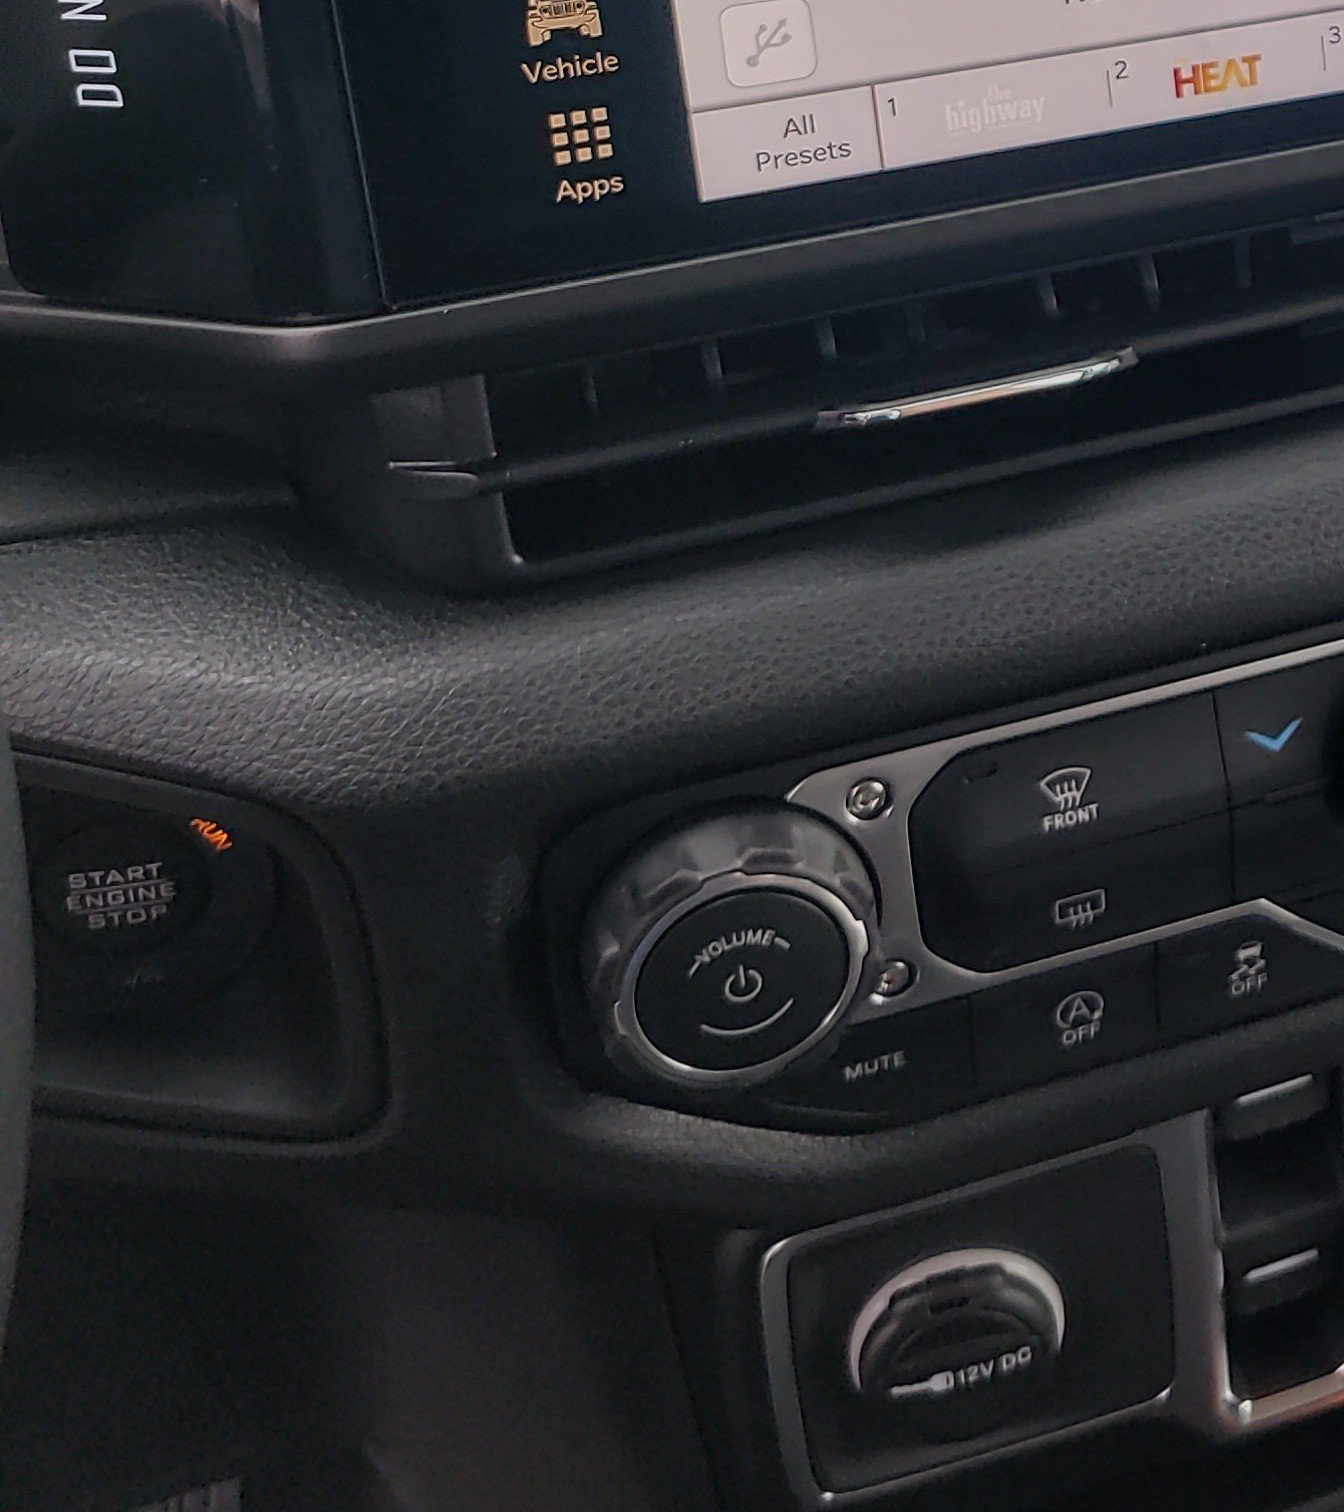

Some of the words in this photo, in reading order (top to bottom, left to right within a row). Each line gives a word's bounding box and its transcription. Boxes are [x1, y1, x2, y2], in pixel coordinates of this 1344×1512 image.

[1328, 26, 1342, 45] 3
[68, 48, 124, 108] DO
[520, 51, 620, 84] Vehicle
[1114, 60, 1130, 80] 2
[1173, 53, 1263, 99] HEAT
[887, 97, 898, 117] 1
[945, 97, 1045, 133] highway
[783, 113, 816, 138] All
[755, 139, 853, 173] Presets
[556, 176, 625, 204] Apps
[1042, 803, 1099, 832] FRONT
[69, 861, 164, 889] START
[66, 882, 176, 910] ENGINE
[88, 904, 167, 929] STOP
[695, 928, 776, 964] VOLUME
[1230, 972, 1268, 996] OFF
[1062, 1021, 1101, 1046] OFF
[842, 1049, 907, 1081] MUTE
[956, 1359, 994, 1386] 12V
[1001, 1346, 1033, 1372] DC
